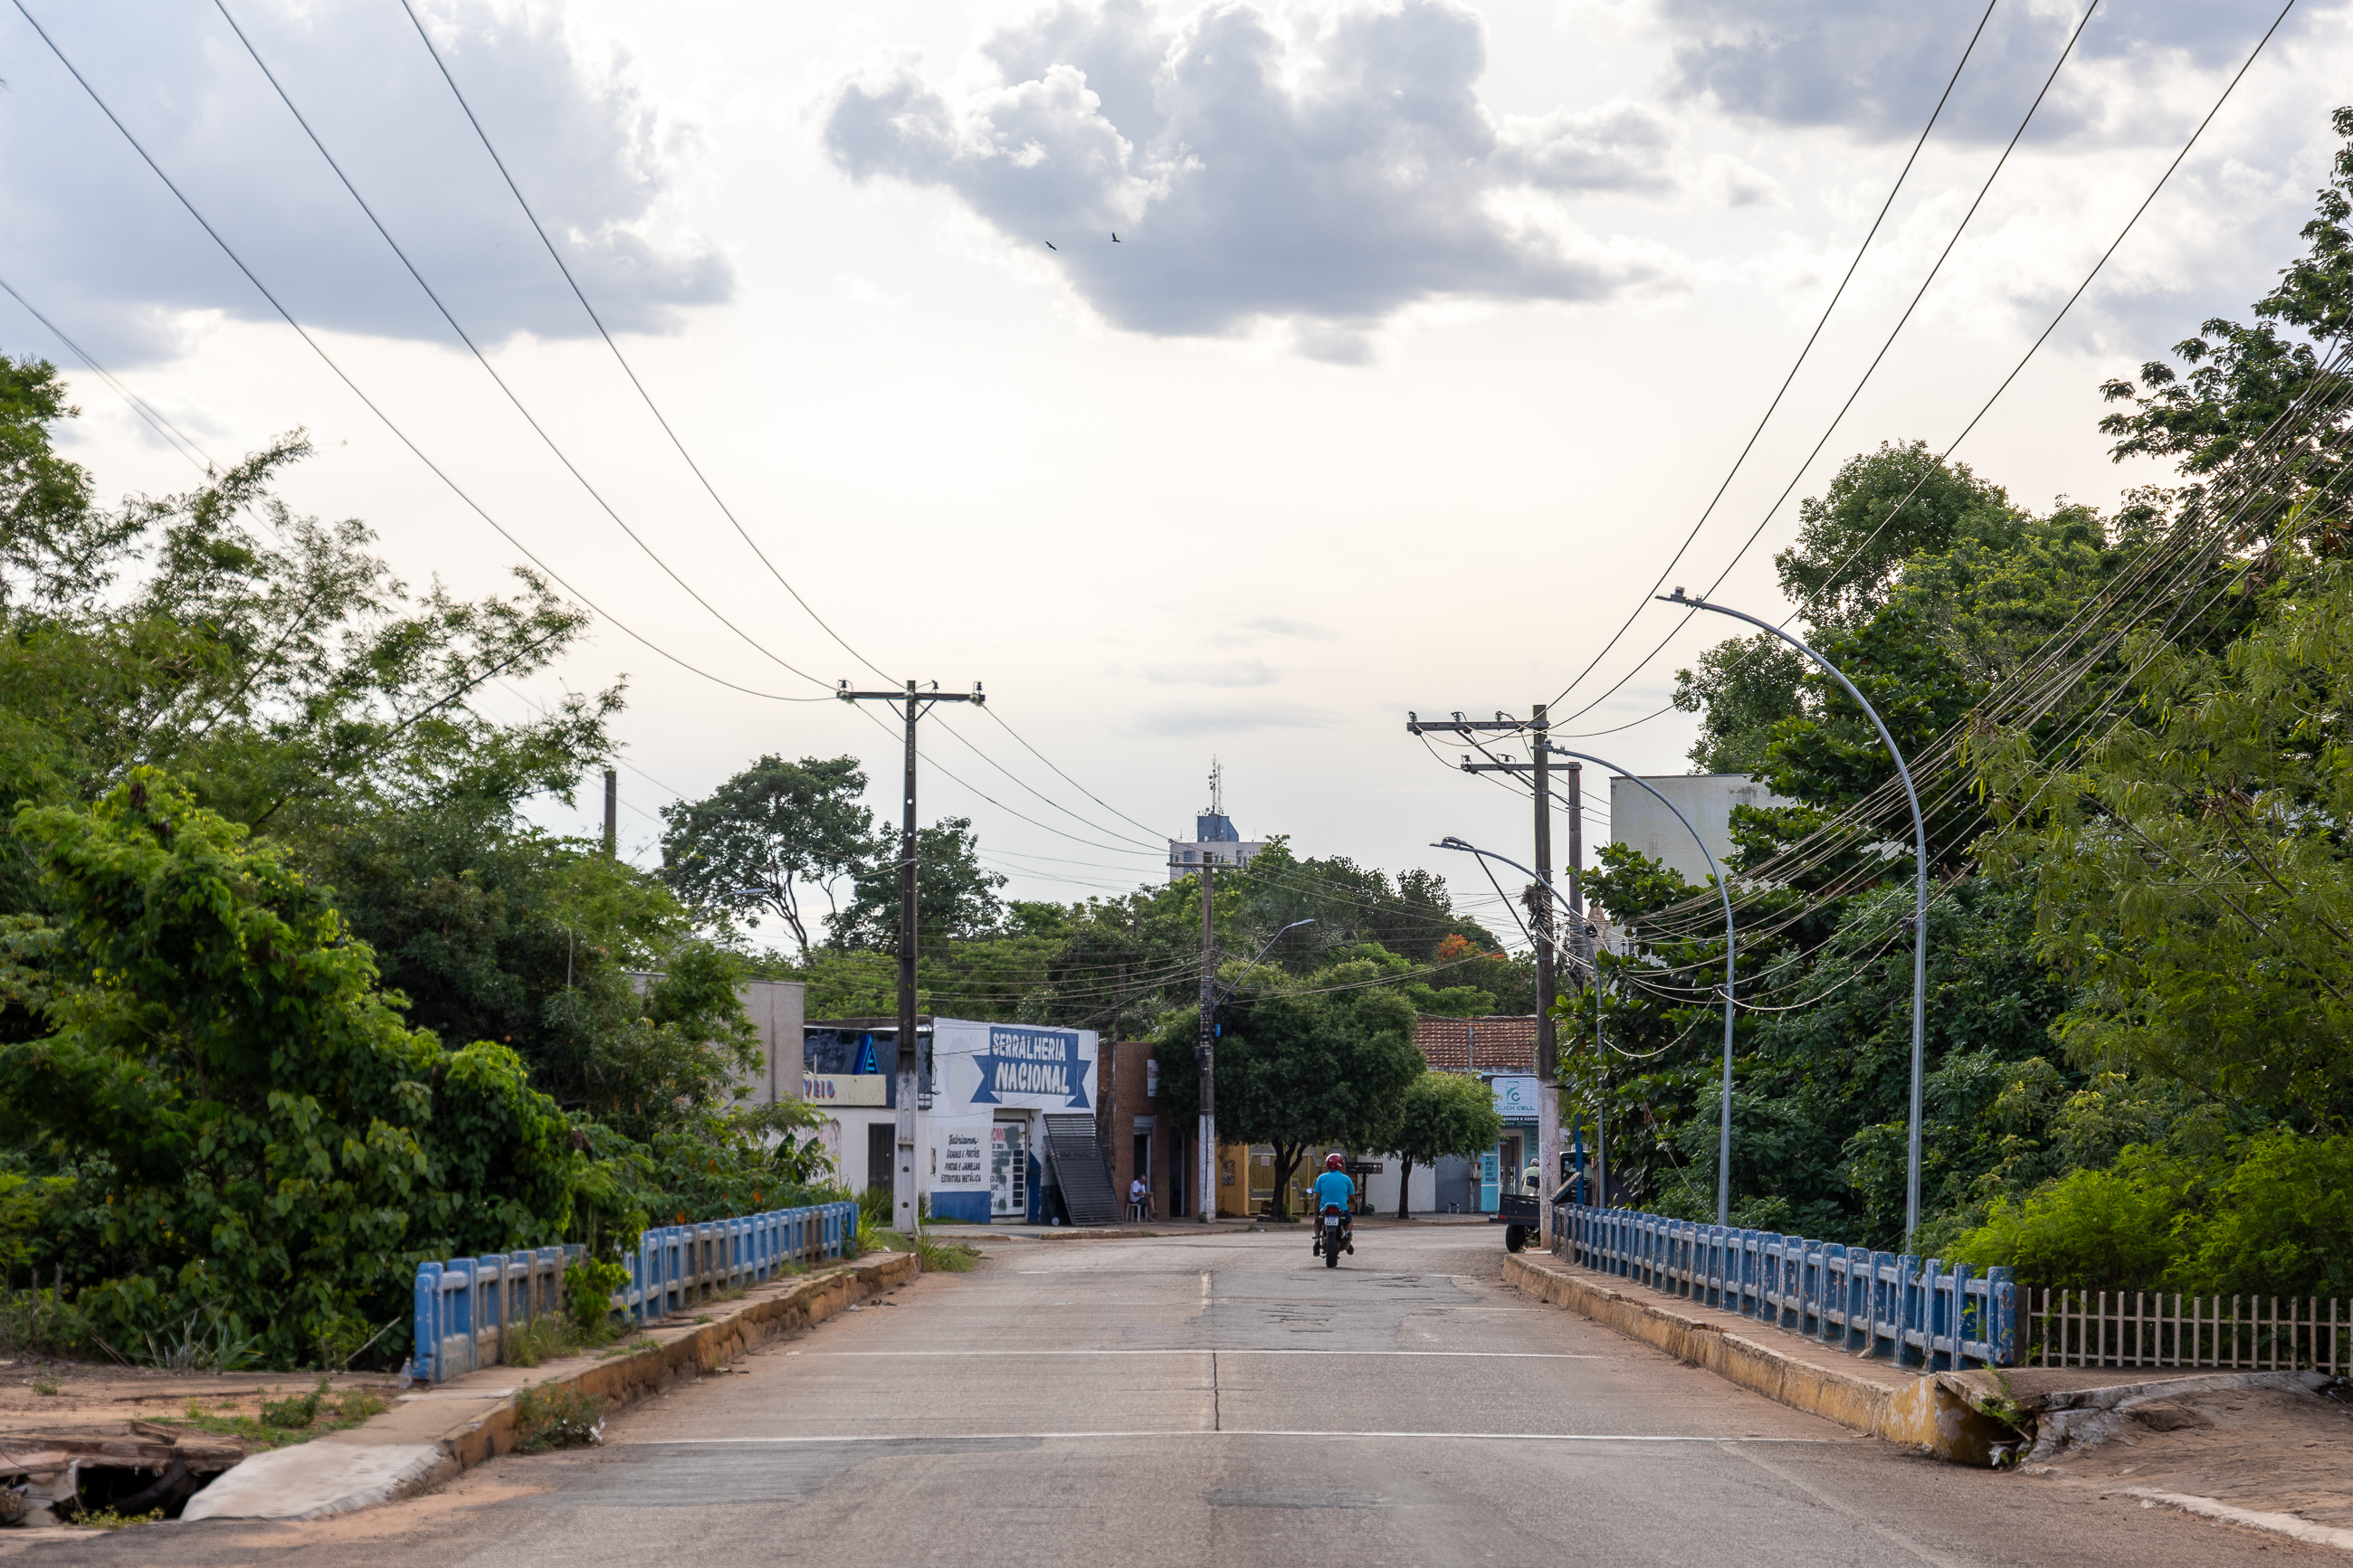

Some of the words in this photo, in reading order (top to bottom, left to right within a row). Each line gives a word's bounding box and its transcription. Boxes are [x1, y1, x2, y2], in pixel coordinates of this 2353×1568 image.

[993, 1032, 1066, 1062] SERRALHERIA
[995, 1062, 1070, 1095] NACIONAL
[947, 1149, 962, 1159] GRADES
[962, 1150, 966, 1158] E
[966, 1147, 980, 1159] PORTÕES
[944, 1163, 957, 1171] PORTAS
[958, 1163, 962, 1171] E
[962, 1163, 981, 1171] JANELAS
[941, 1174, 961, 1183] ESTRUTURA
[962, 1172, 981, 1183] METÁLICA
